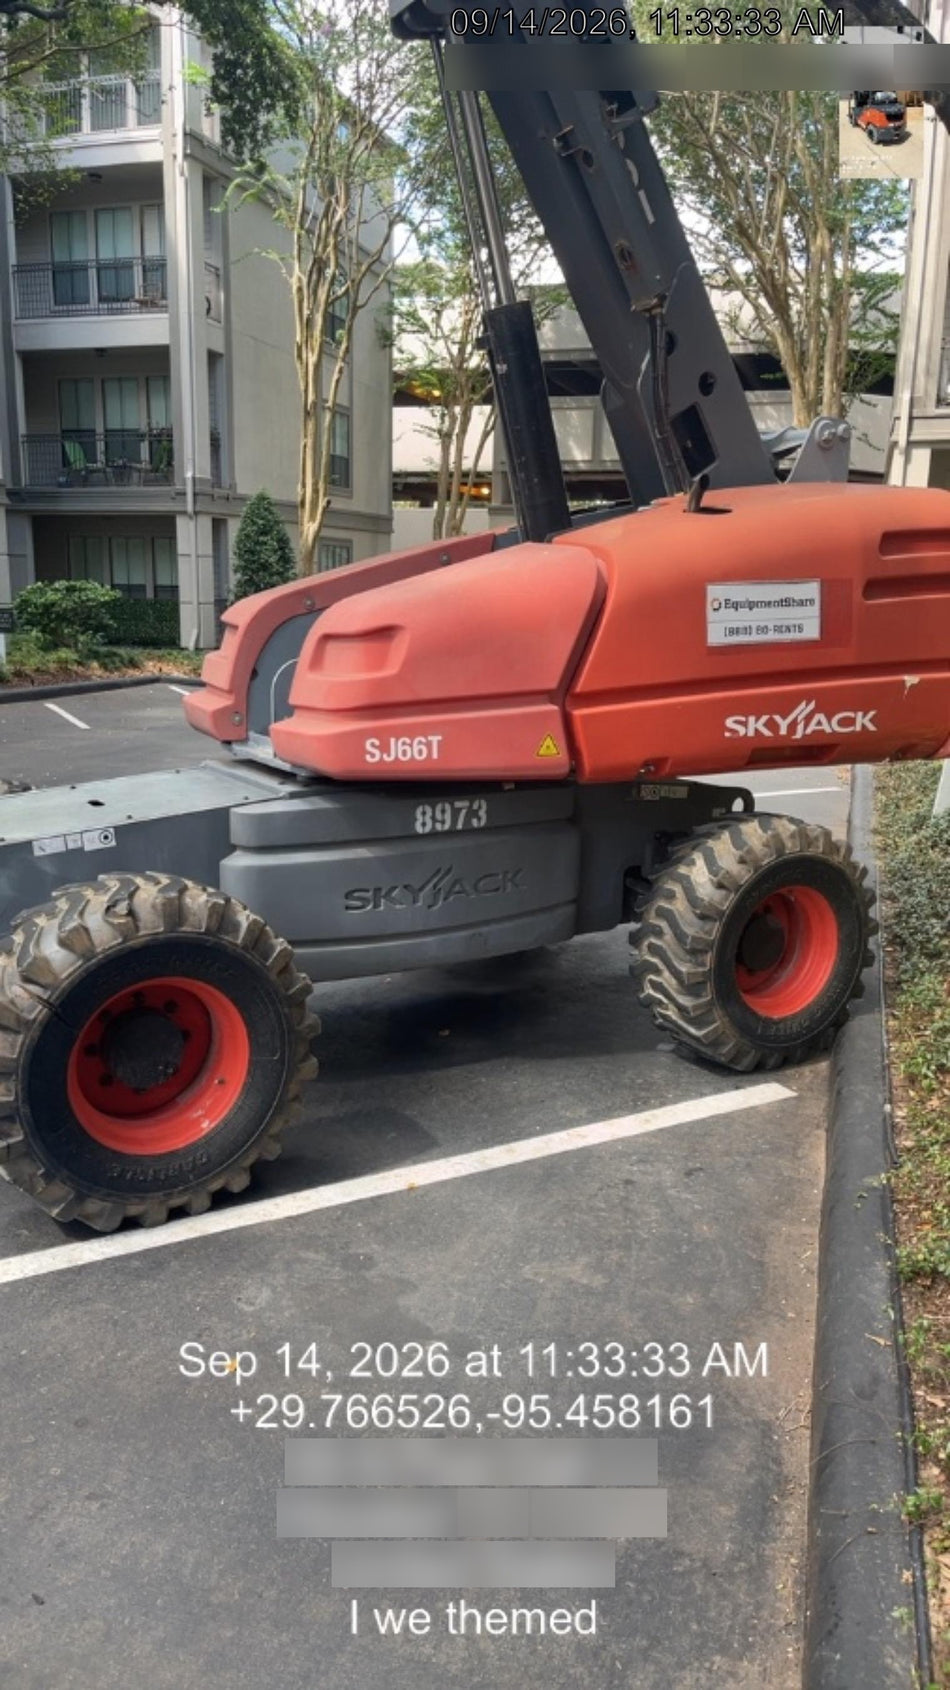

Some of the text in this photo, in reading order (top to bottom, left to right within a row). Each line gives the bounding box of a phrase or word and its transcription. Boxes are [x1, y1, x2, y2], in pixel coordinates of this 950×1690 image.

[723, 597, 816, 612] EquipmentShare
[724, 700, 878, 739] SKYJACK
[365, 735, 443, 763] SJ66T
[414, 799, 488, 834] 8973
[344, 864, 527, 914] SKYJACK
